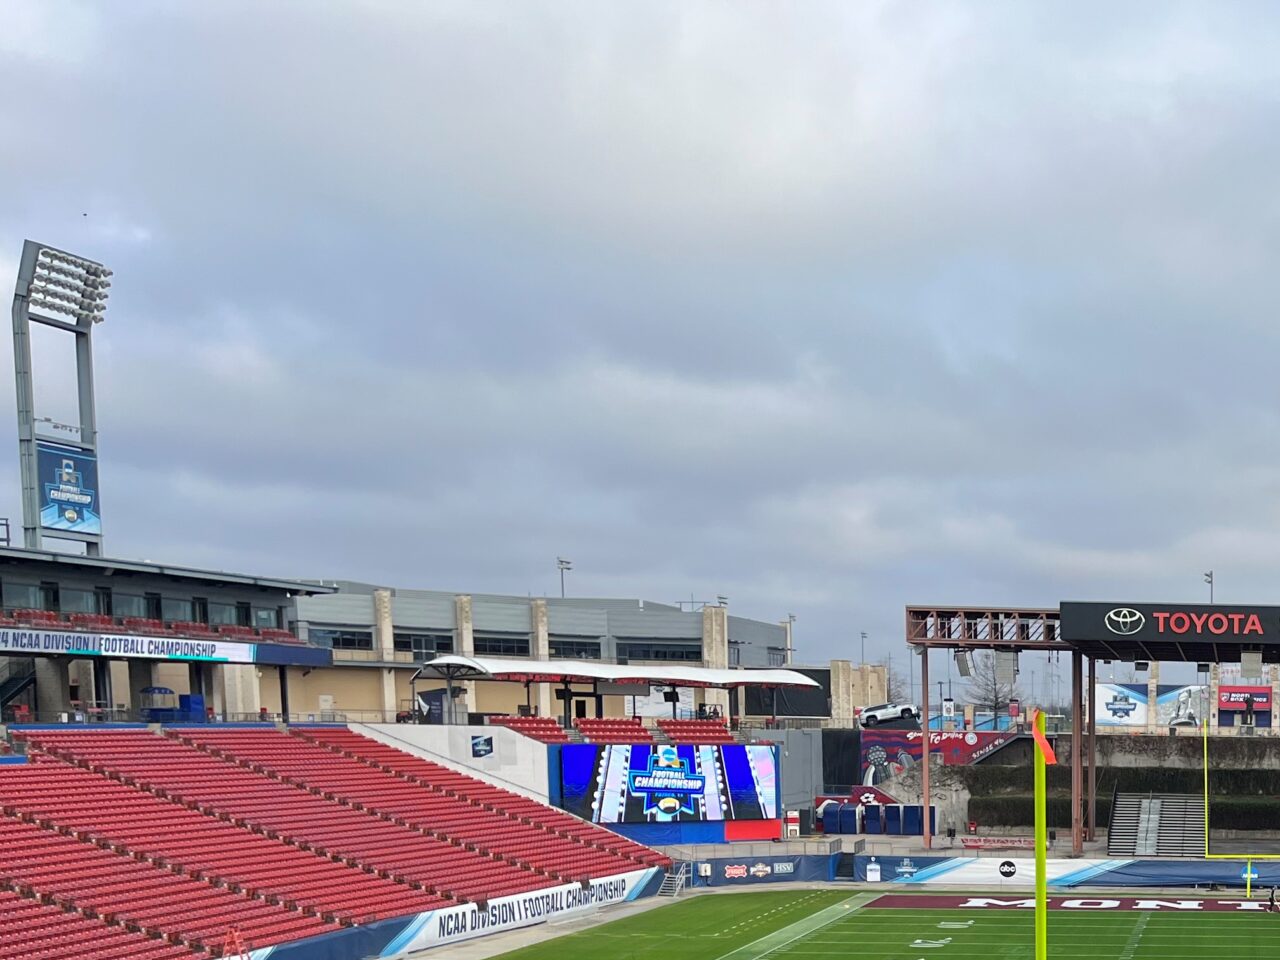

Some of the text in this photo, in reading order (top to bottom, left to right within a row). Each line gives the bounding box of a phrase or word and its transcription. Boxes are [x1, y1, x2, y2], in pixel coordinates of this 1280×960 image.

[1153, 612, 1264, 635] TOYOTA
[12, 631, 39, 649] NCAA
[44, 634, 88, 650] DIVISION
[100, 637, 145, 655] FOOTBALL
[147, 642, 216, 657] CHAMPIONSHIP
[634, 776, 703, 790] CHAMPIONSHIP
[652, 770, 686, 780] FOOTBALL
[1000, 863, 1016, 873] abc
[439, 878, 626, 938] NCAA DIVISION I FOOTBALL CHAMPIONSHIP
